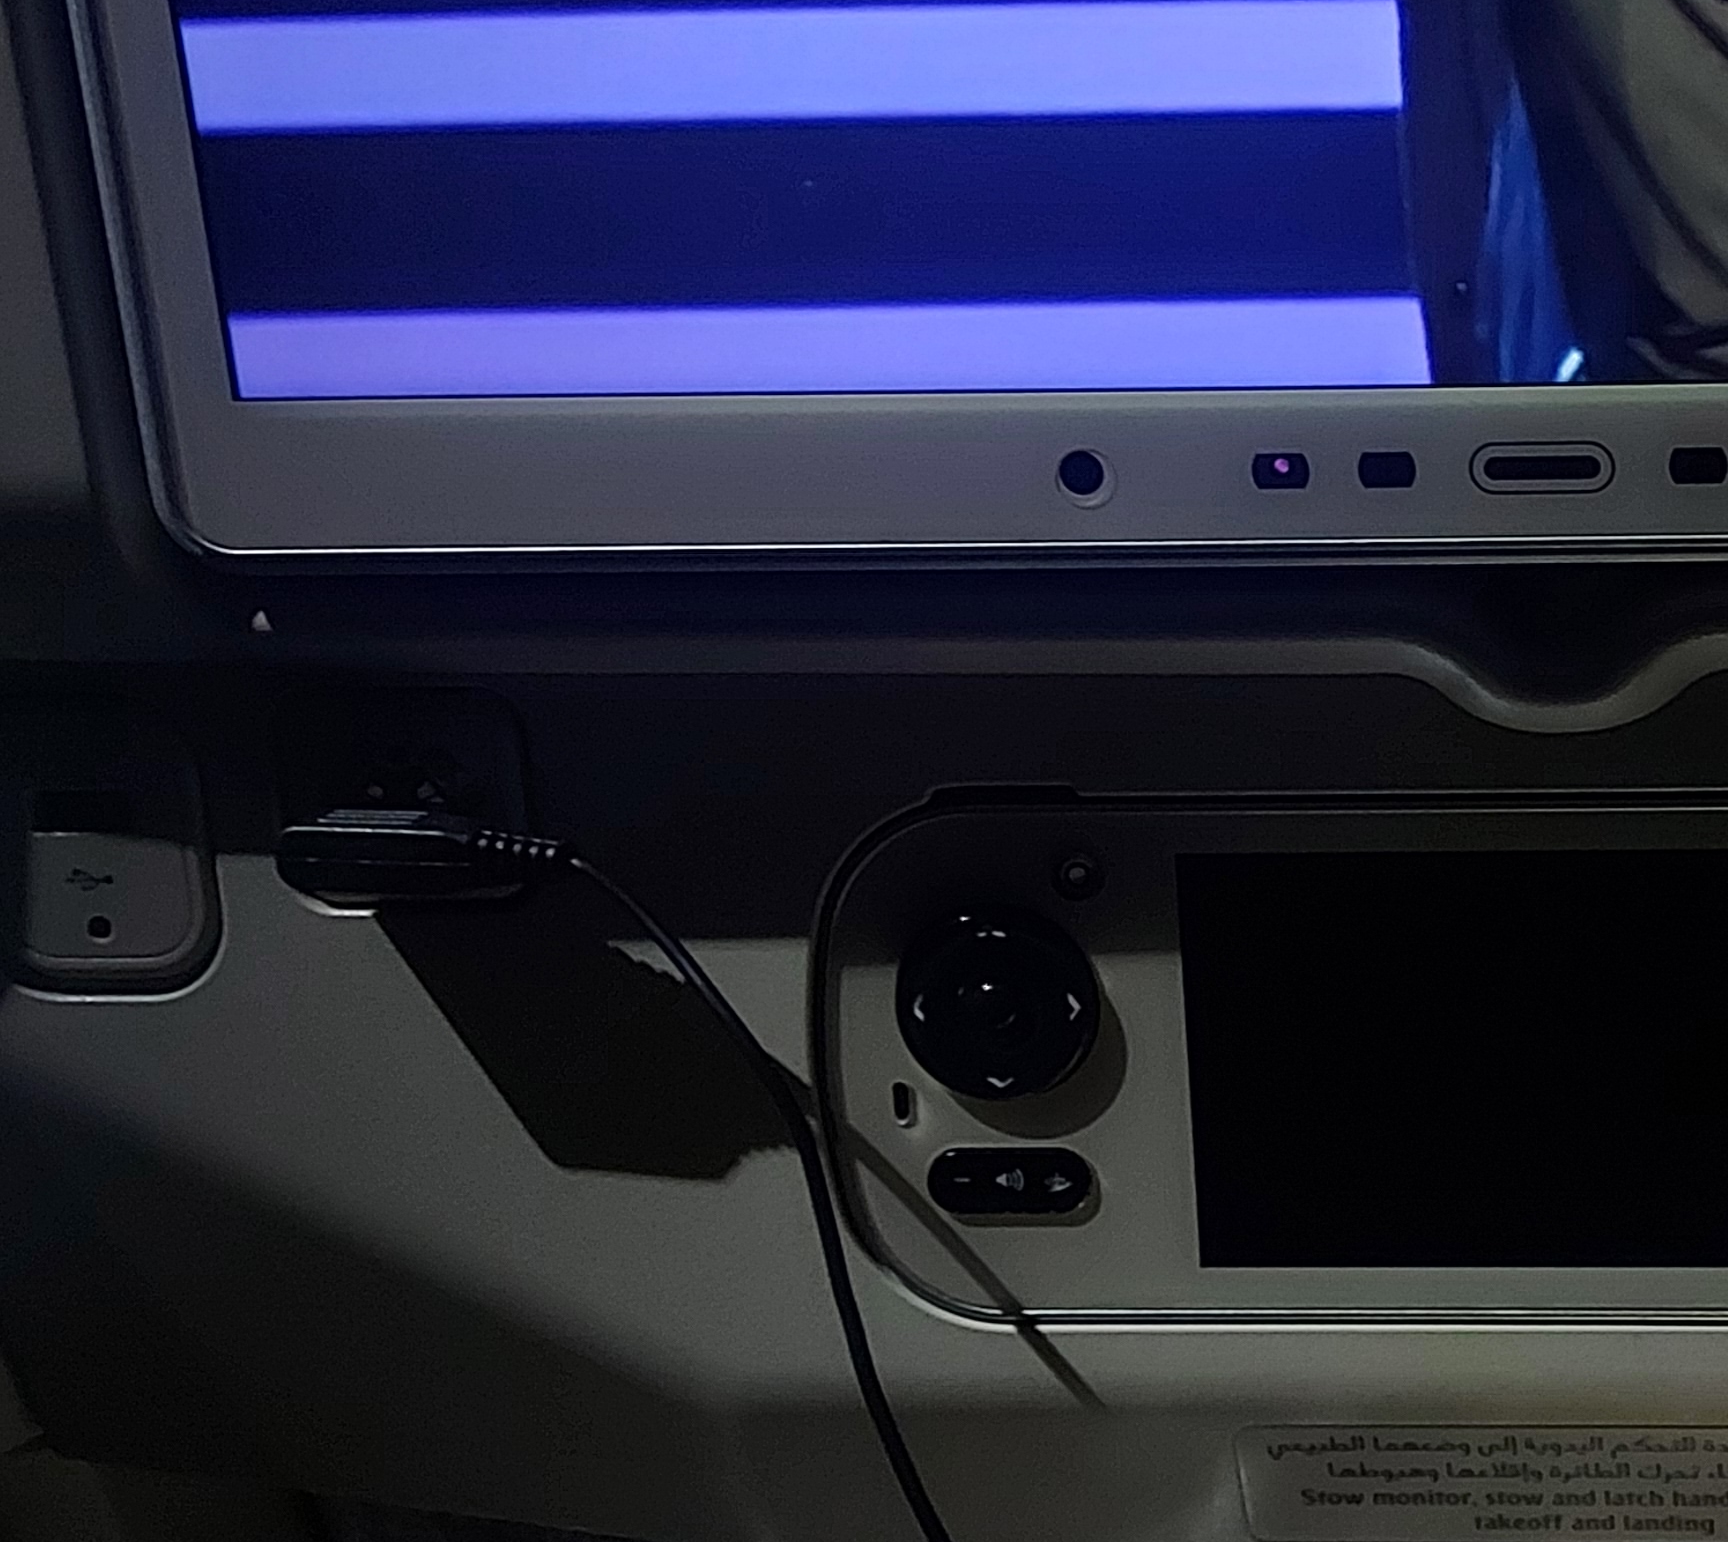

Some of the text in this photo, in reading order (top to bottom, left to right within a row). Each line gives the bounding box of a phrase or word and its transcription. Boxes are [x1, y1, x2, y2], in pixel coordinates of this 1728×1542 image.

[1300, 1488, 1366, 1507] Stow
[1372, 1487, 1478, 1508] monitor,
[1485, 1488, 1545, 1507] stow
[1551, 1488, 1598, 1507] and
[1603, 1489, 1666, 1508] latch
[1474, 1513, 1716, 1536] takeoff and landing
